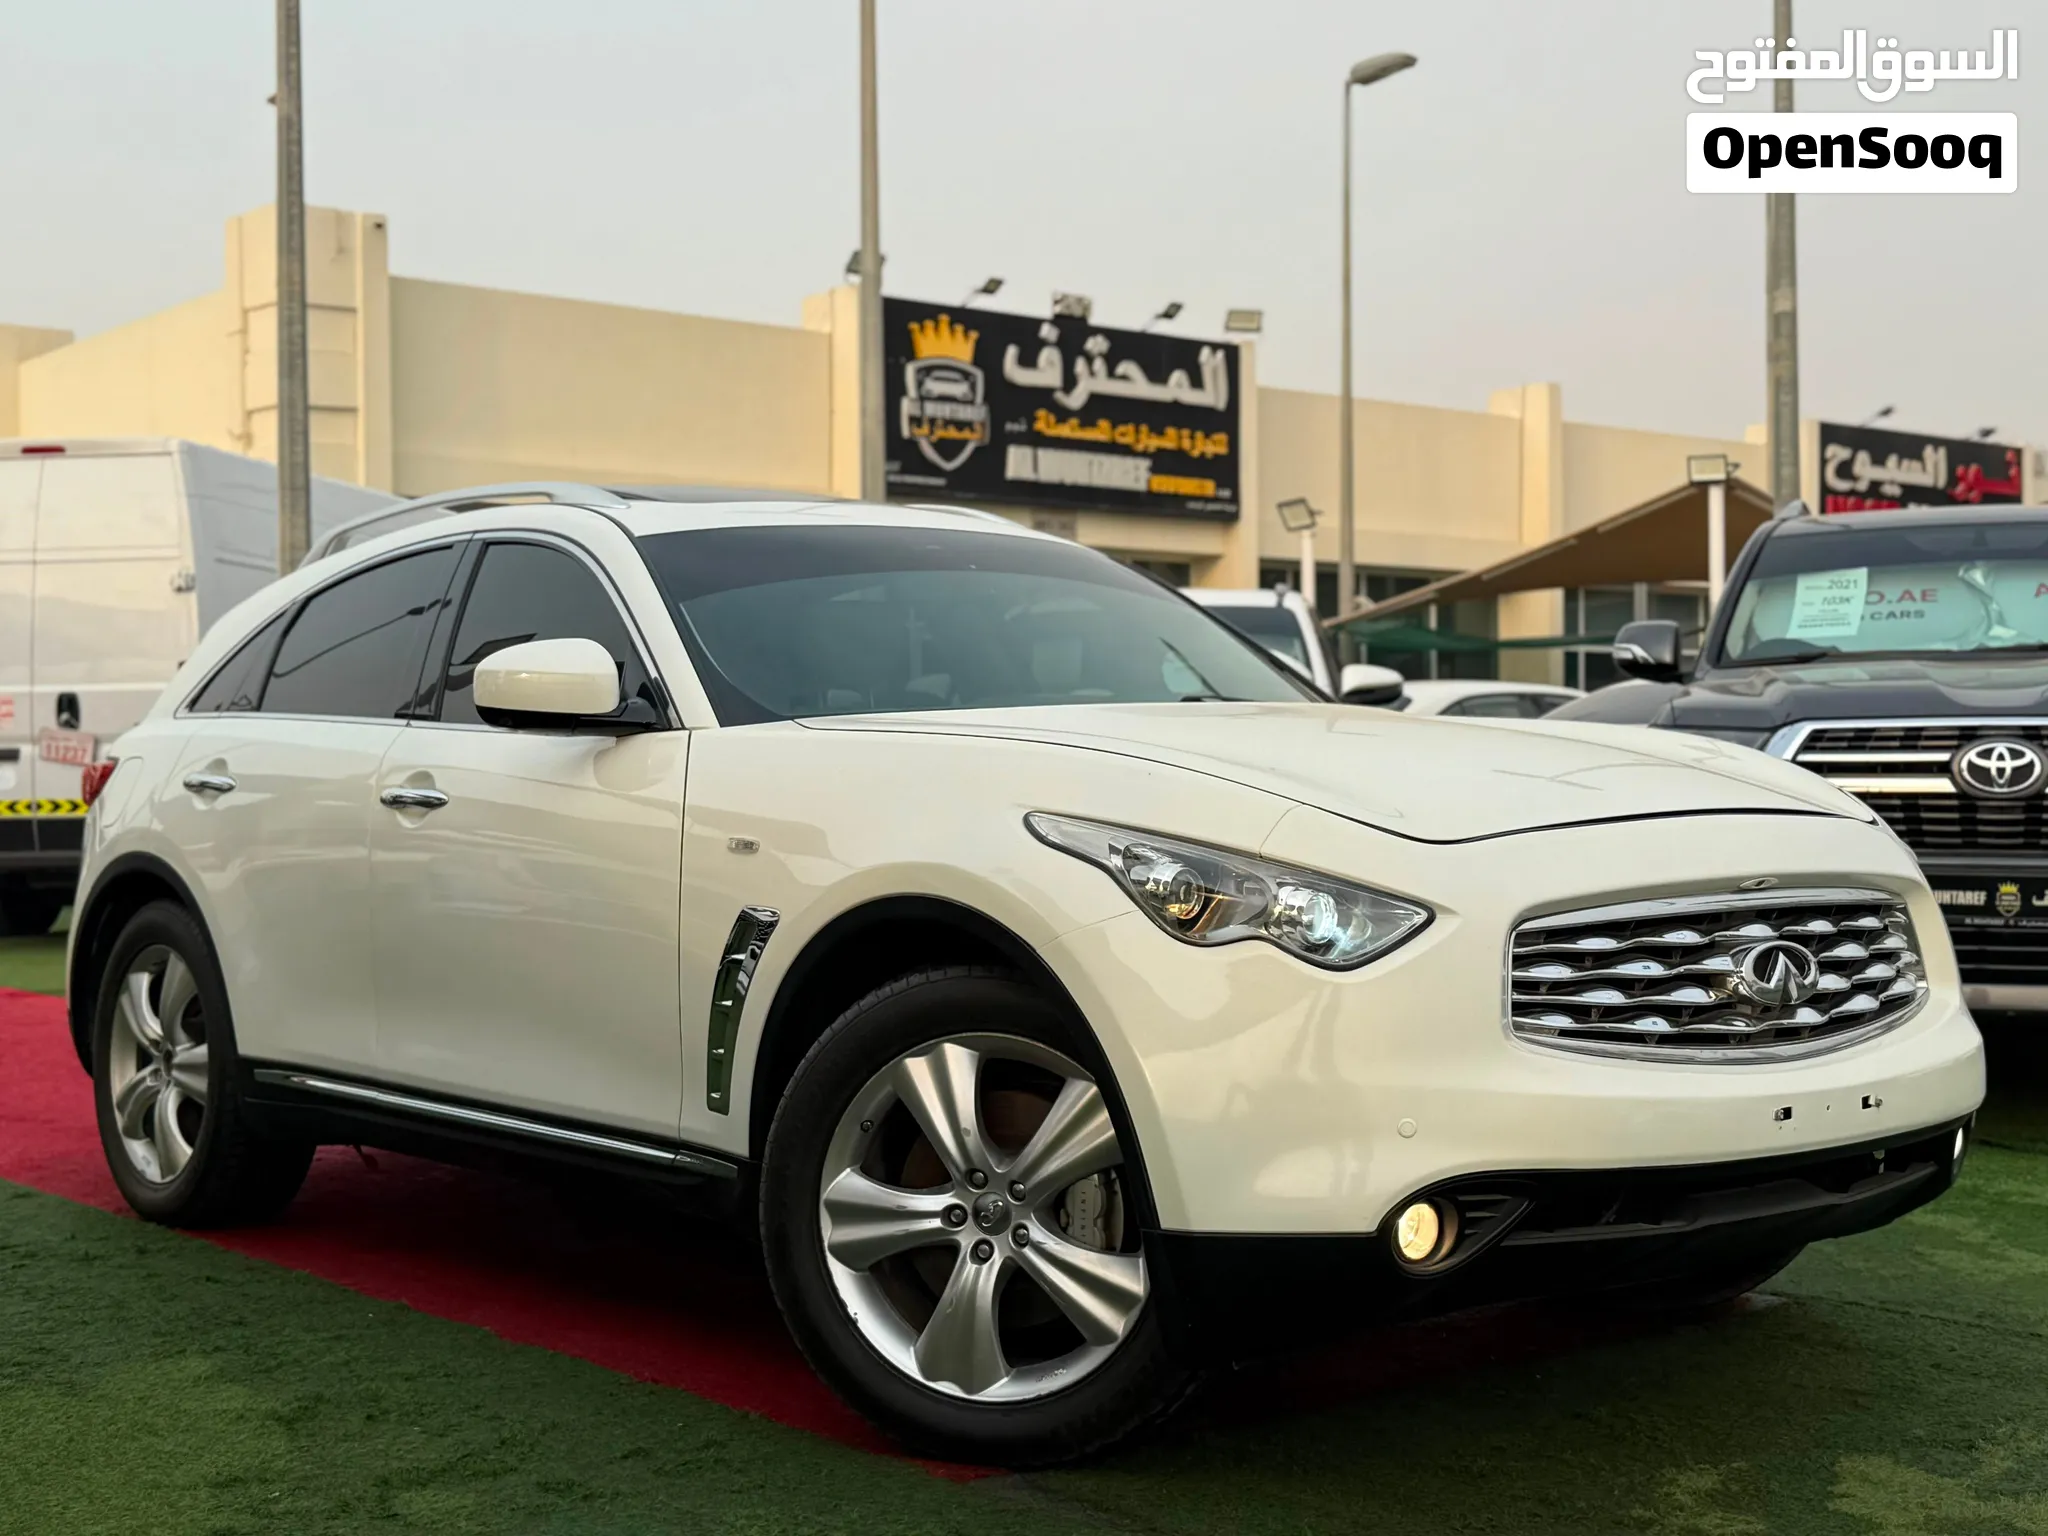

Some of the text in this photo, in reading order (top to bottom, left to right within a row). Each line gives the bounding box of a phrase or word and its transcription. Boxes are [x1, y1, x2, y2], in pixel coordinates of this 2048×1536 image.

[1003, 321, 1229, 412] المحترف
[1827, 579, 1858, 590] 2021
[1869, 609, 1925, 621] CARS
[1932, 890, 1988, 906] UHTAREF
